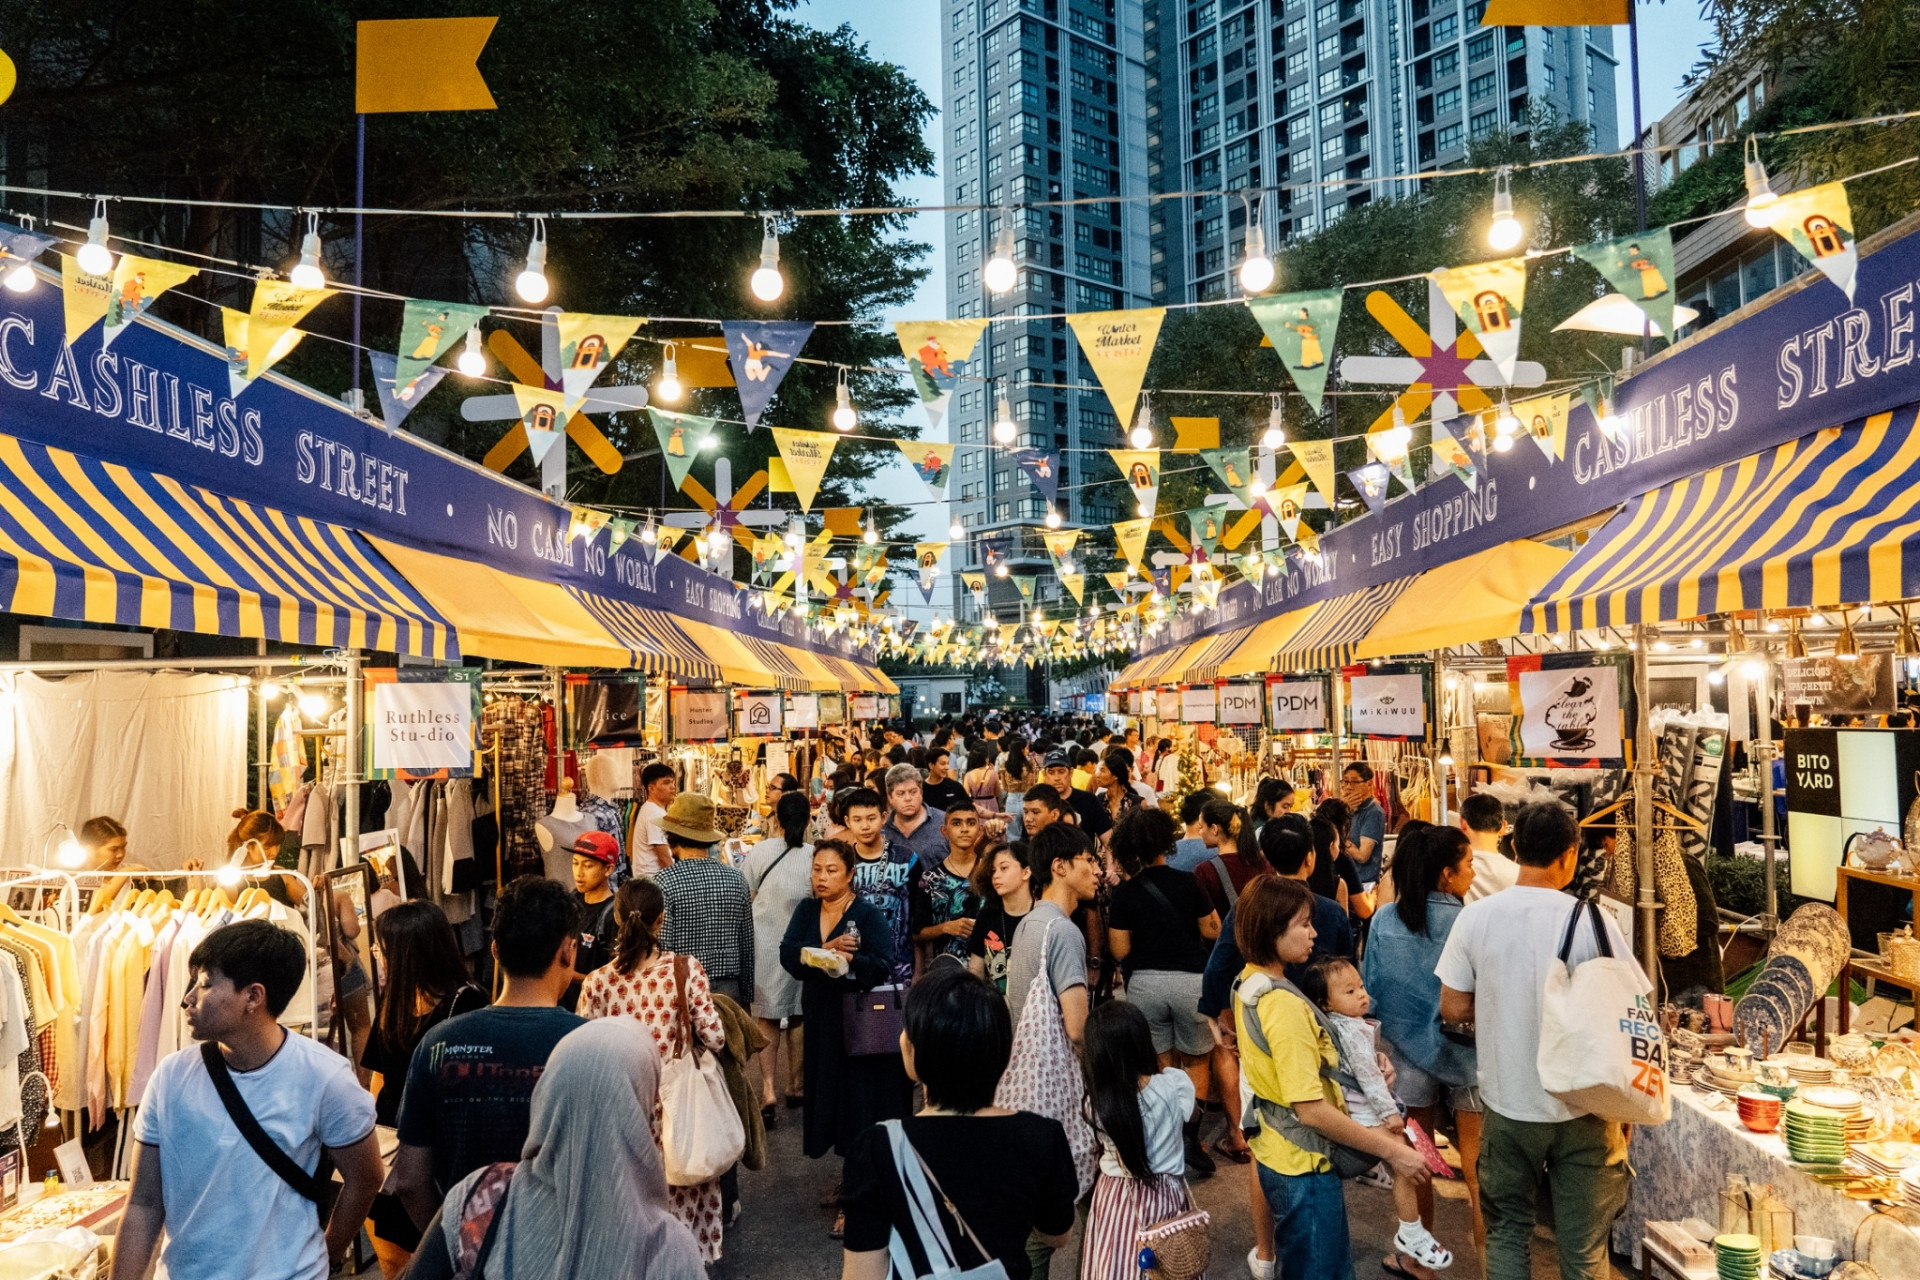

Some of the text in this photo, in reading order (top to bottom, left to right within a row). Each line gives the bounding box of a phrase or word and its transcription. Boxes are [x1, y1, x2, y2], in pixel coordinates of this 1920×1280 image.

[1096, 334, 1141, 347] Market
[1572, 283, 1920, 486] CASHLESS STRE
[0, 311, 409, 515] CASHLESS STREET
[1371, 478, 1498, 567] EASY SHOPPING
[487, 504, 658, 595] NO CASH NO WORRY
[1287, 570, 1300, 599] NO
[1304, 550, 1338, 591] WORRY
[684, 576, 706, 609] EASY
[1592, 656, 1616, 666] S11
[454, 672, 470, 681] S1
[1787, 666, 1831, 677] DELICIOUS
[1789, 681, 1833, 691] SPAGHETTI
[1223, 697, 1257, 710] PDM
[1276, 696, 1319, 711] PDM
[385, 710, 461, 725] Ruthless
[1562, 711, 1579, 720] the
[390, 727, 456, 742] Stu-dio
[1797, 754, 1830, 770] BITO
[1796, 771, 1834, 790] YARD
[1618, 1018, 1659, 1041] REC
[445, 1044, 494, 1055] MONSTER
[1631, 1036, 1666, 1073] BA
